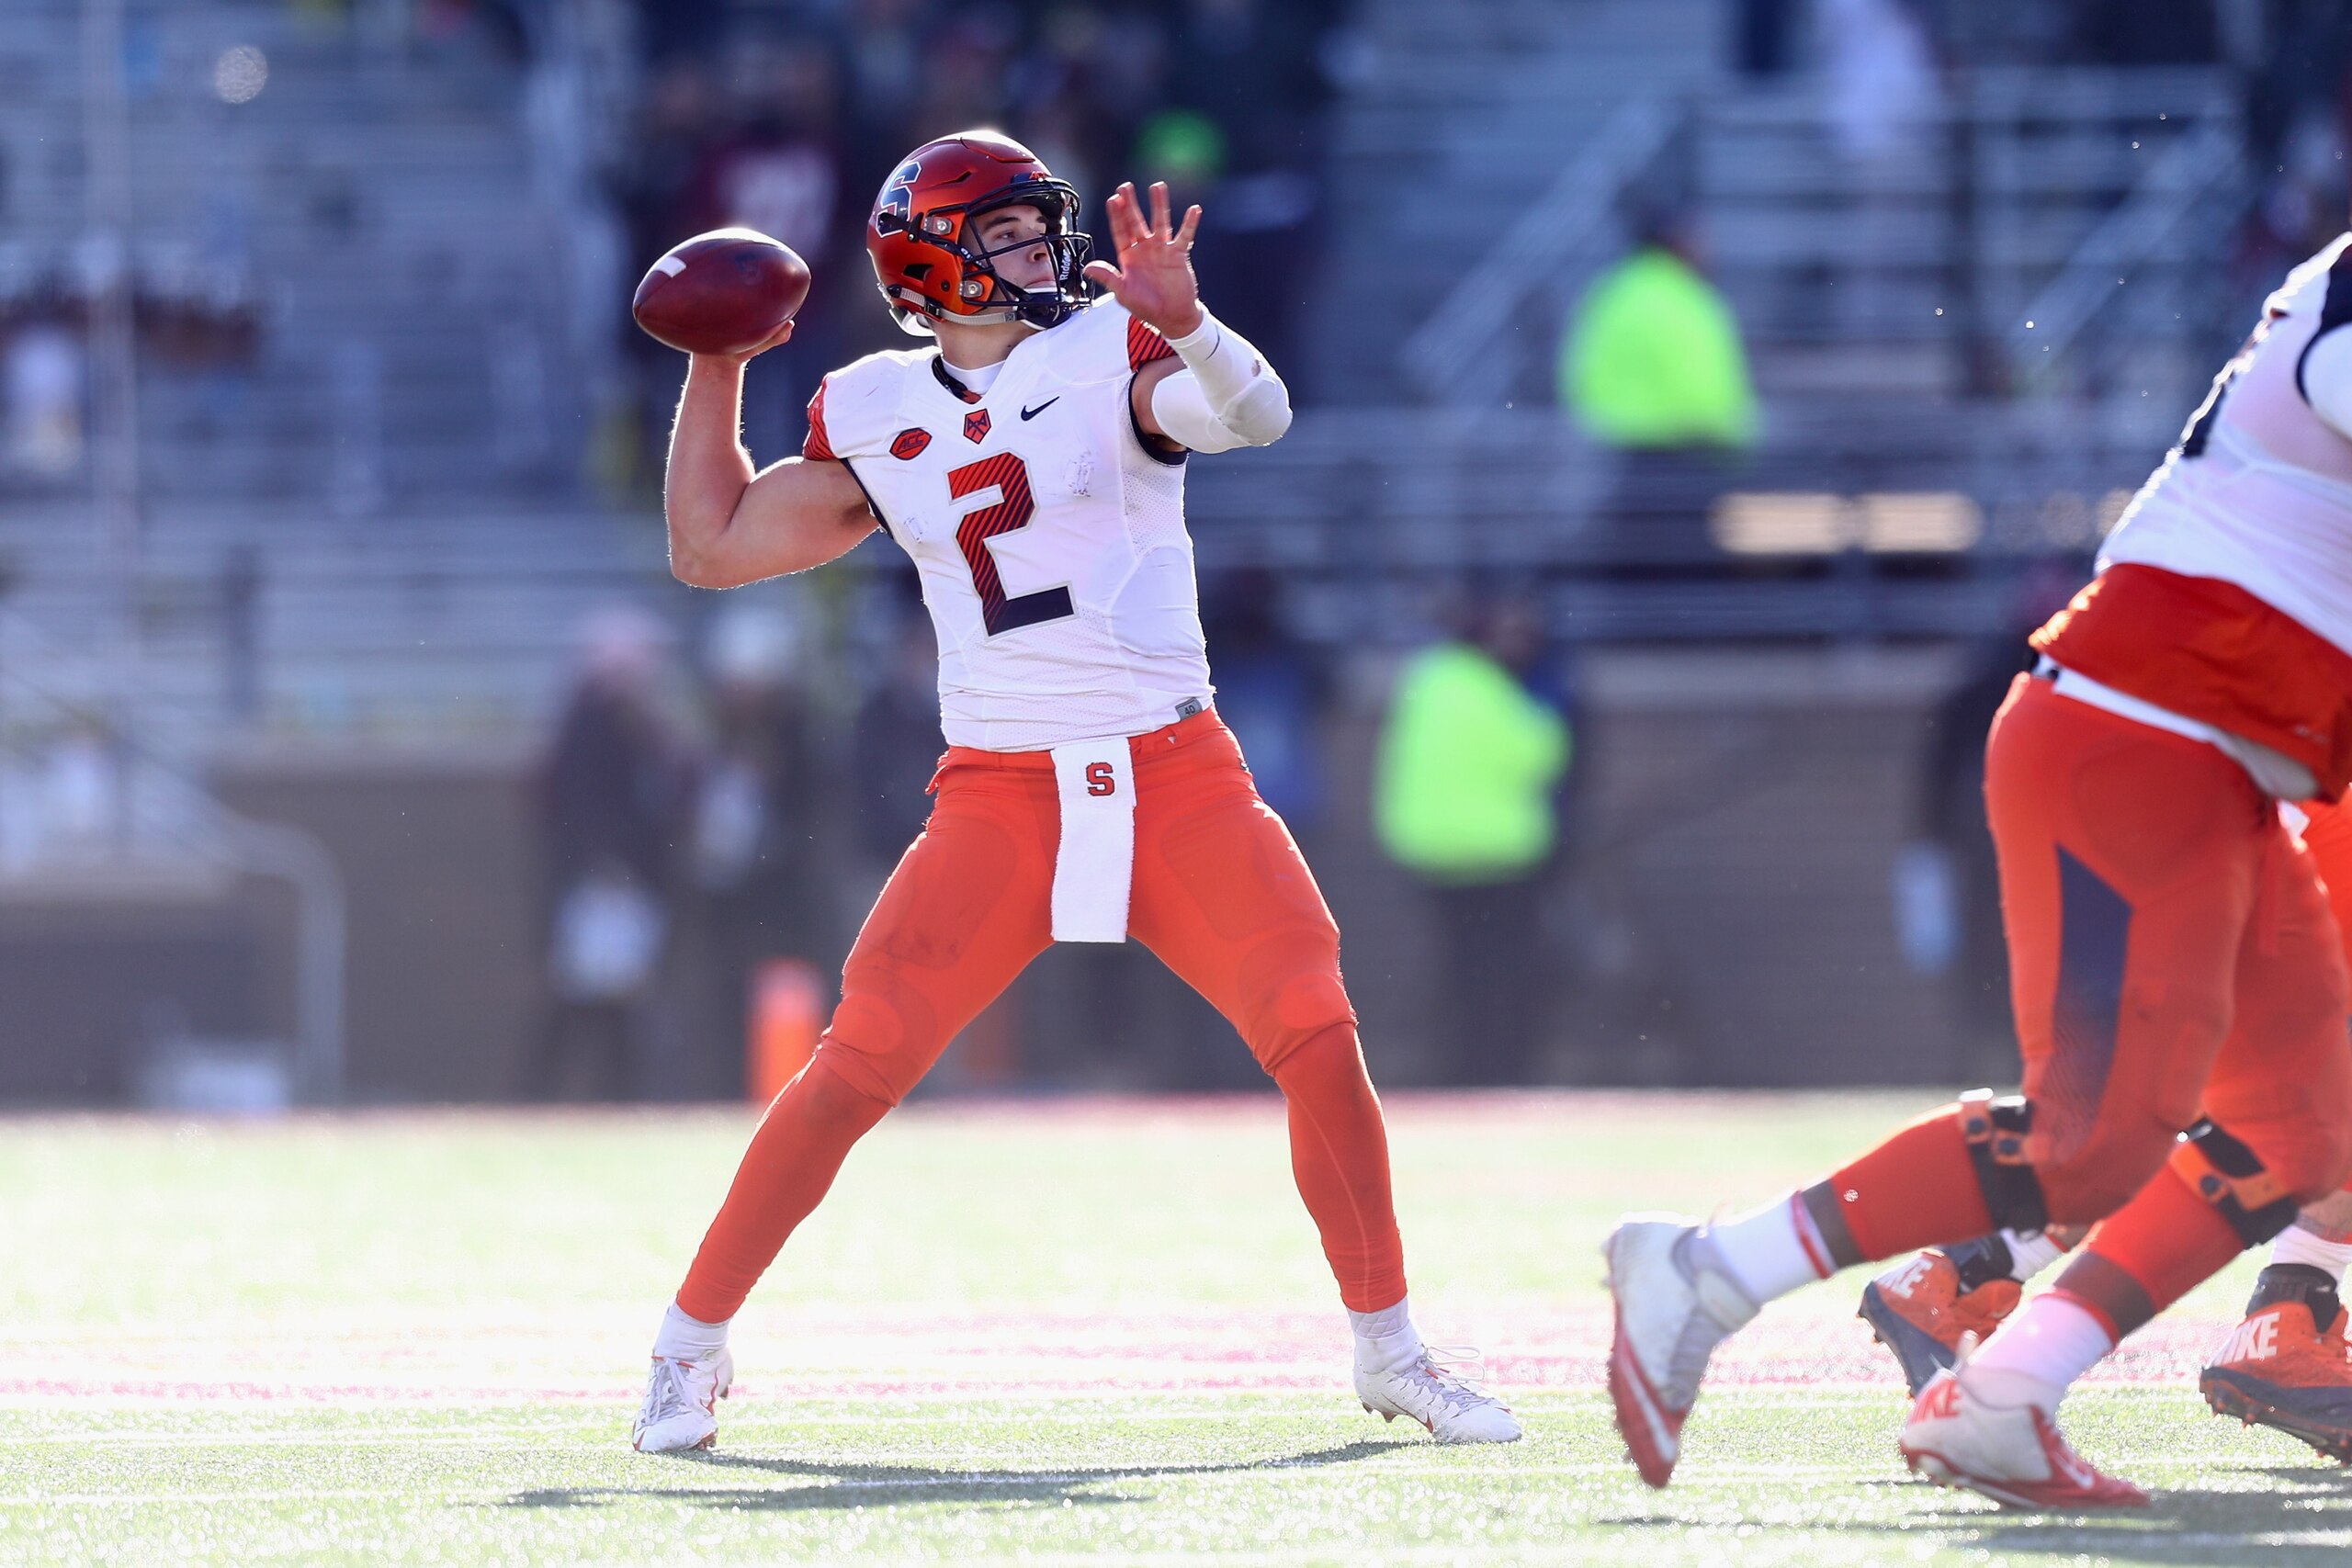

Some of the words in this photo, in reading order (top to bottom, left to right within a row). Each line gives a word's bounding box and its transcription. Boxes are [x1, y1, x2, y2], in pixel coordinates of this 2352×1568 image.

[897, 432, 925, 453] ACC
[945, 448, 1080, 641] 2
[1184, 705, 1196, 716] 40
[1086, 761, 1114, 796] S
[1875, 1258, 1933, 1299] IKE
[1909, 1378, 1962, 1424] IKE
